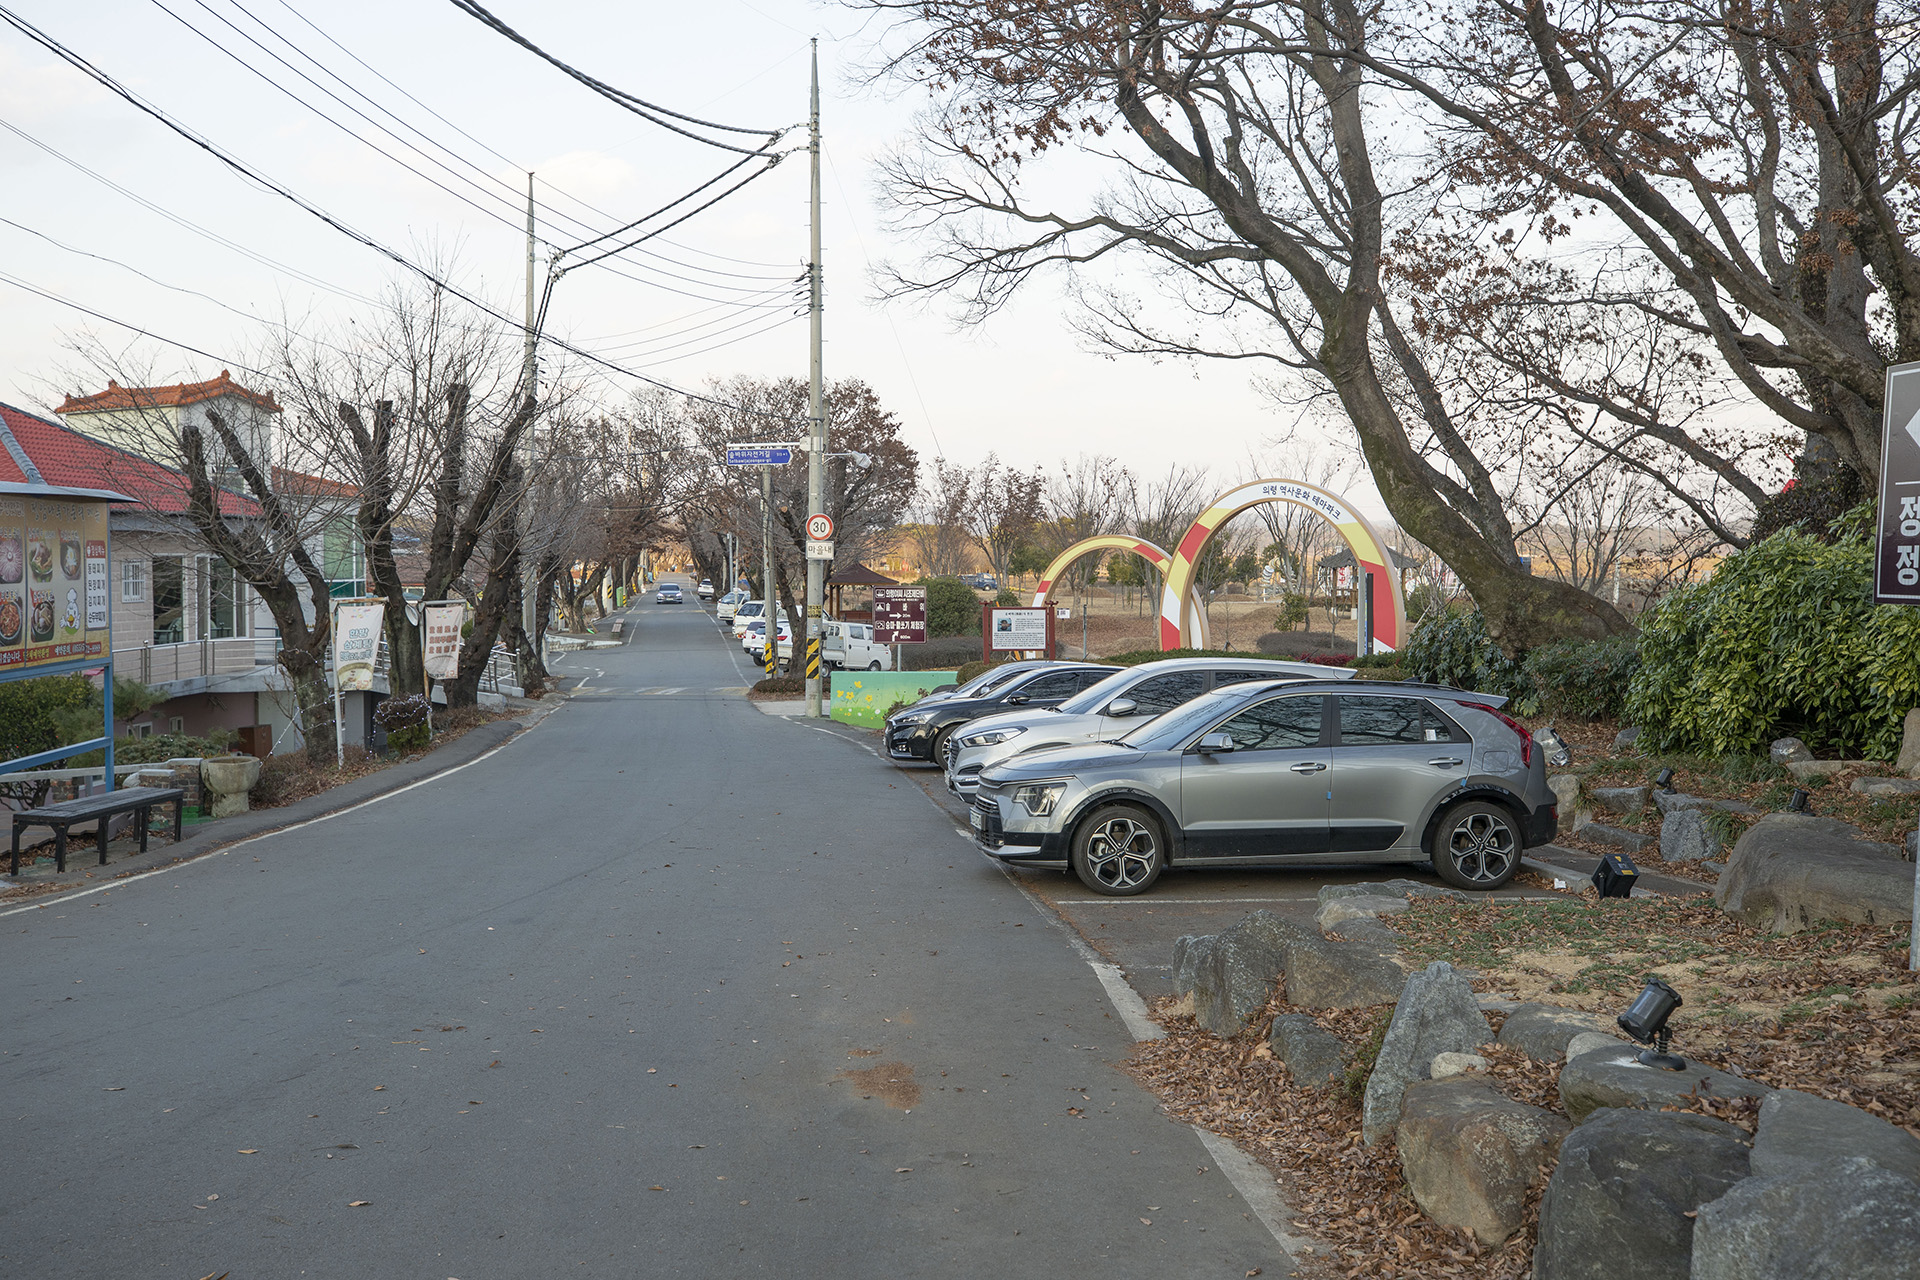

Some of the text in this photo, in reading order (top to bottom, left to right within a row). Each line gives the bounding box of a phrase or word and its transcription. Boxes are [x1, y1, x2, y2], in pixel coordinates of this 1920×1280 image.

[1262, 485, 1341, 520] 의령 역사문화 테마파크
[813, 521, 826, 533] 30
[808, 545, 832, 555] 마을내
[88, 579, 106, 591] 된장찌개
[88, 595, 106, 607] 김치찌개
[88, 611, 106, 623] 순두부찌개
[911, 621, 924, 629] 체험장
[349, 628, 369, 639] 한방
[344, 639, 373, 650] 삼계탕
